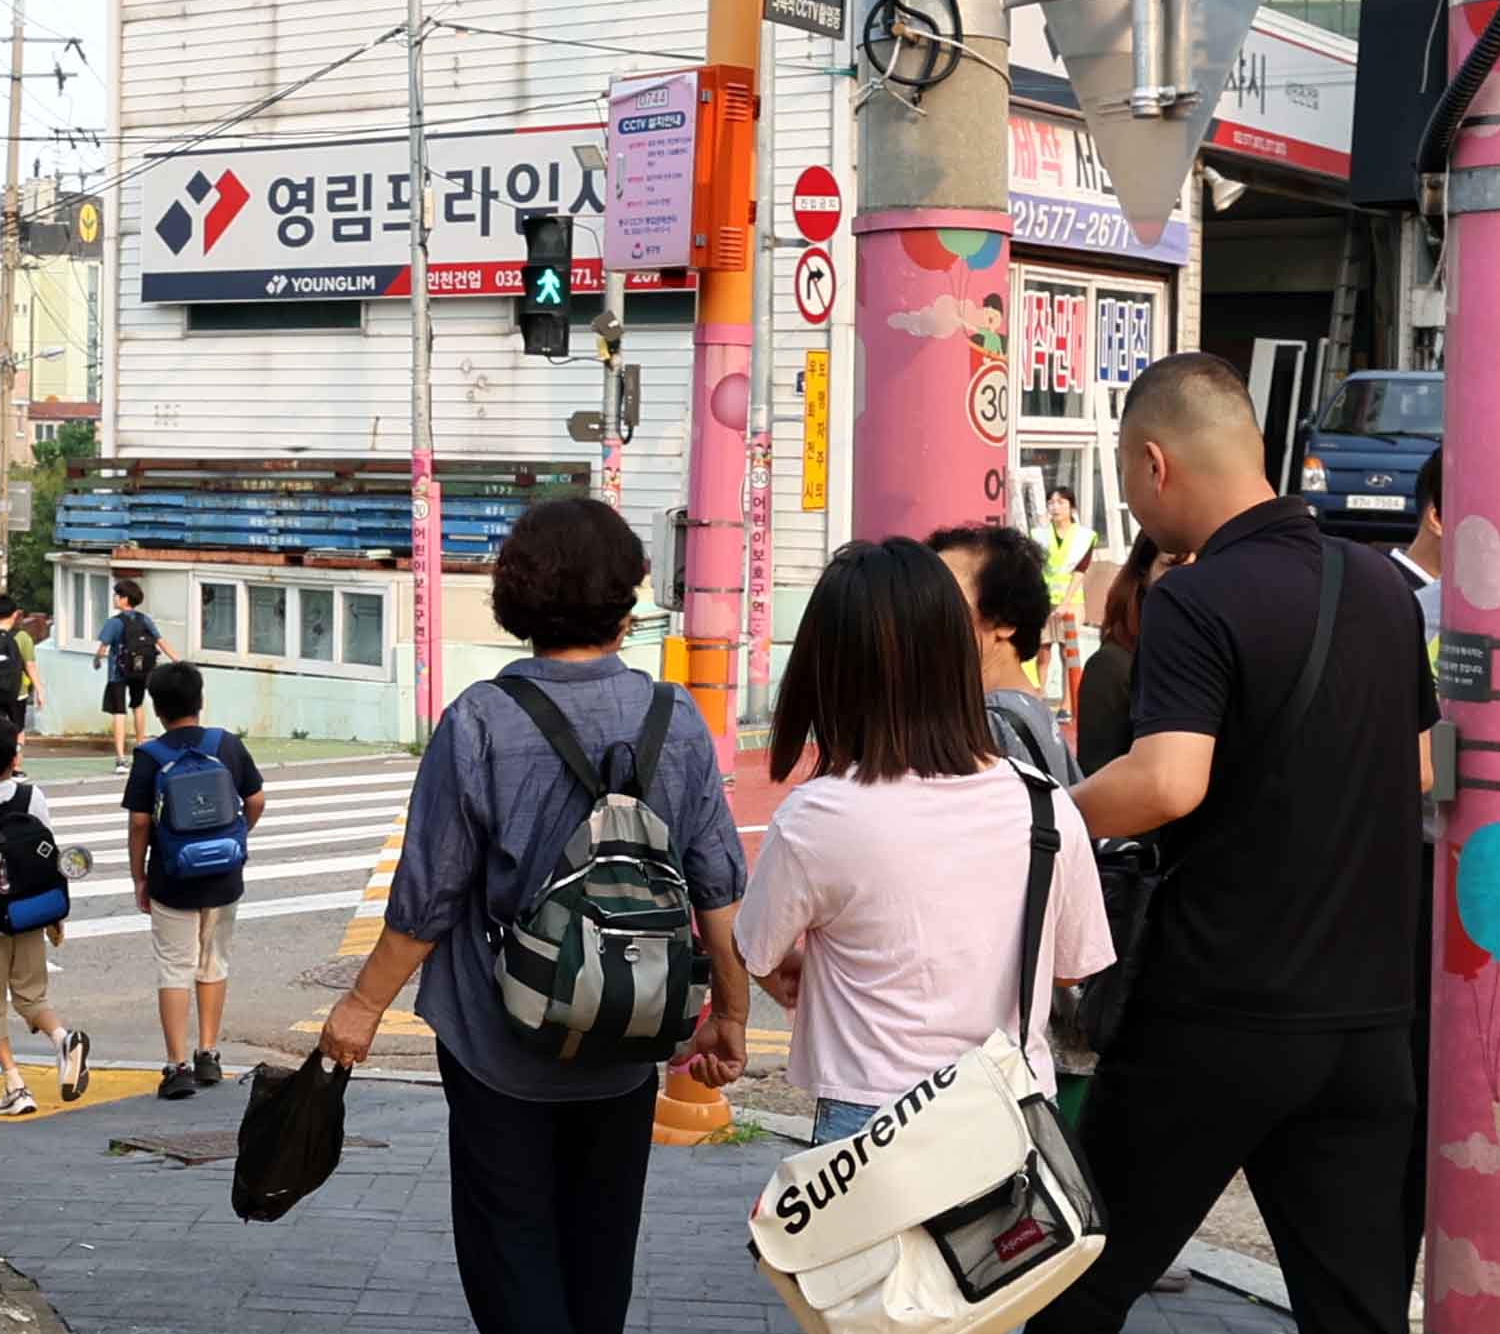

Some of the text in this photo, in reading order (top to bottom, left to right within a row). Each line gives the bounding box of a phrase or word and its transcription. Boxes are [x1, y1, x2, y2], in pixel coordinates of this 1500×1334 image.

[622, 118, 648, 132] CCTV
[1009, 199, 1131, 250] 2)577-2671
[291, 275, 375, 294] YOUNGLIM
[428, 270, 482, 290] 인천건업
[751, 470, 769, 485] 30
[775, 1063, 958, 1237] Supreme
